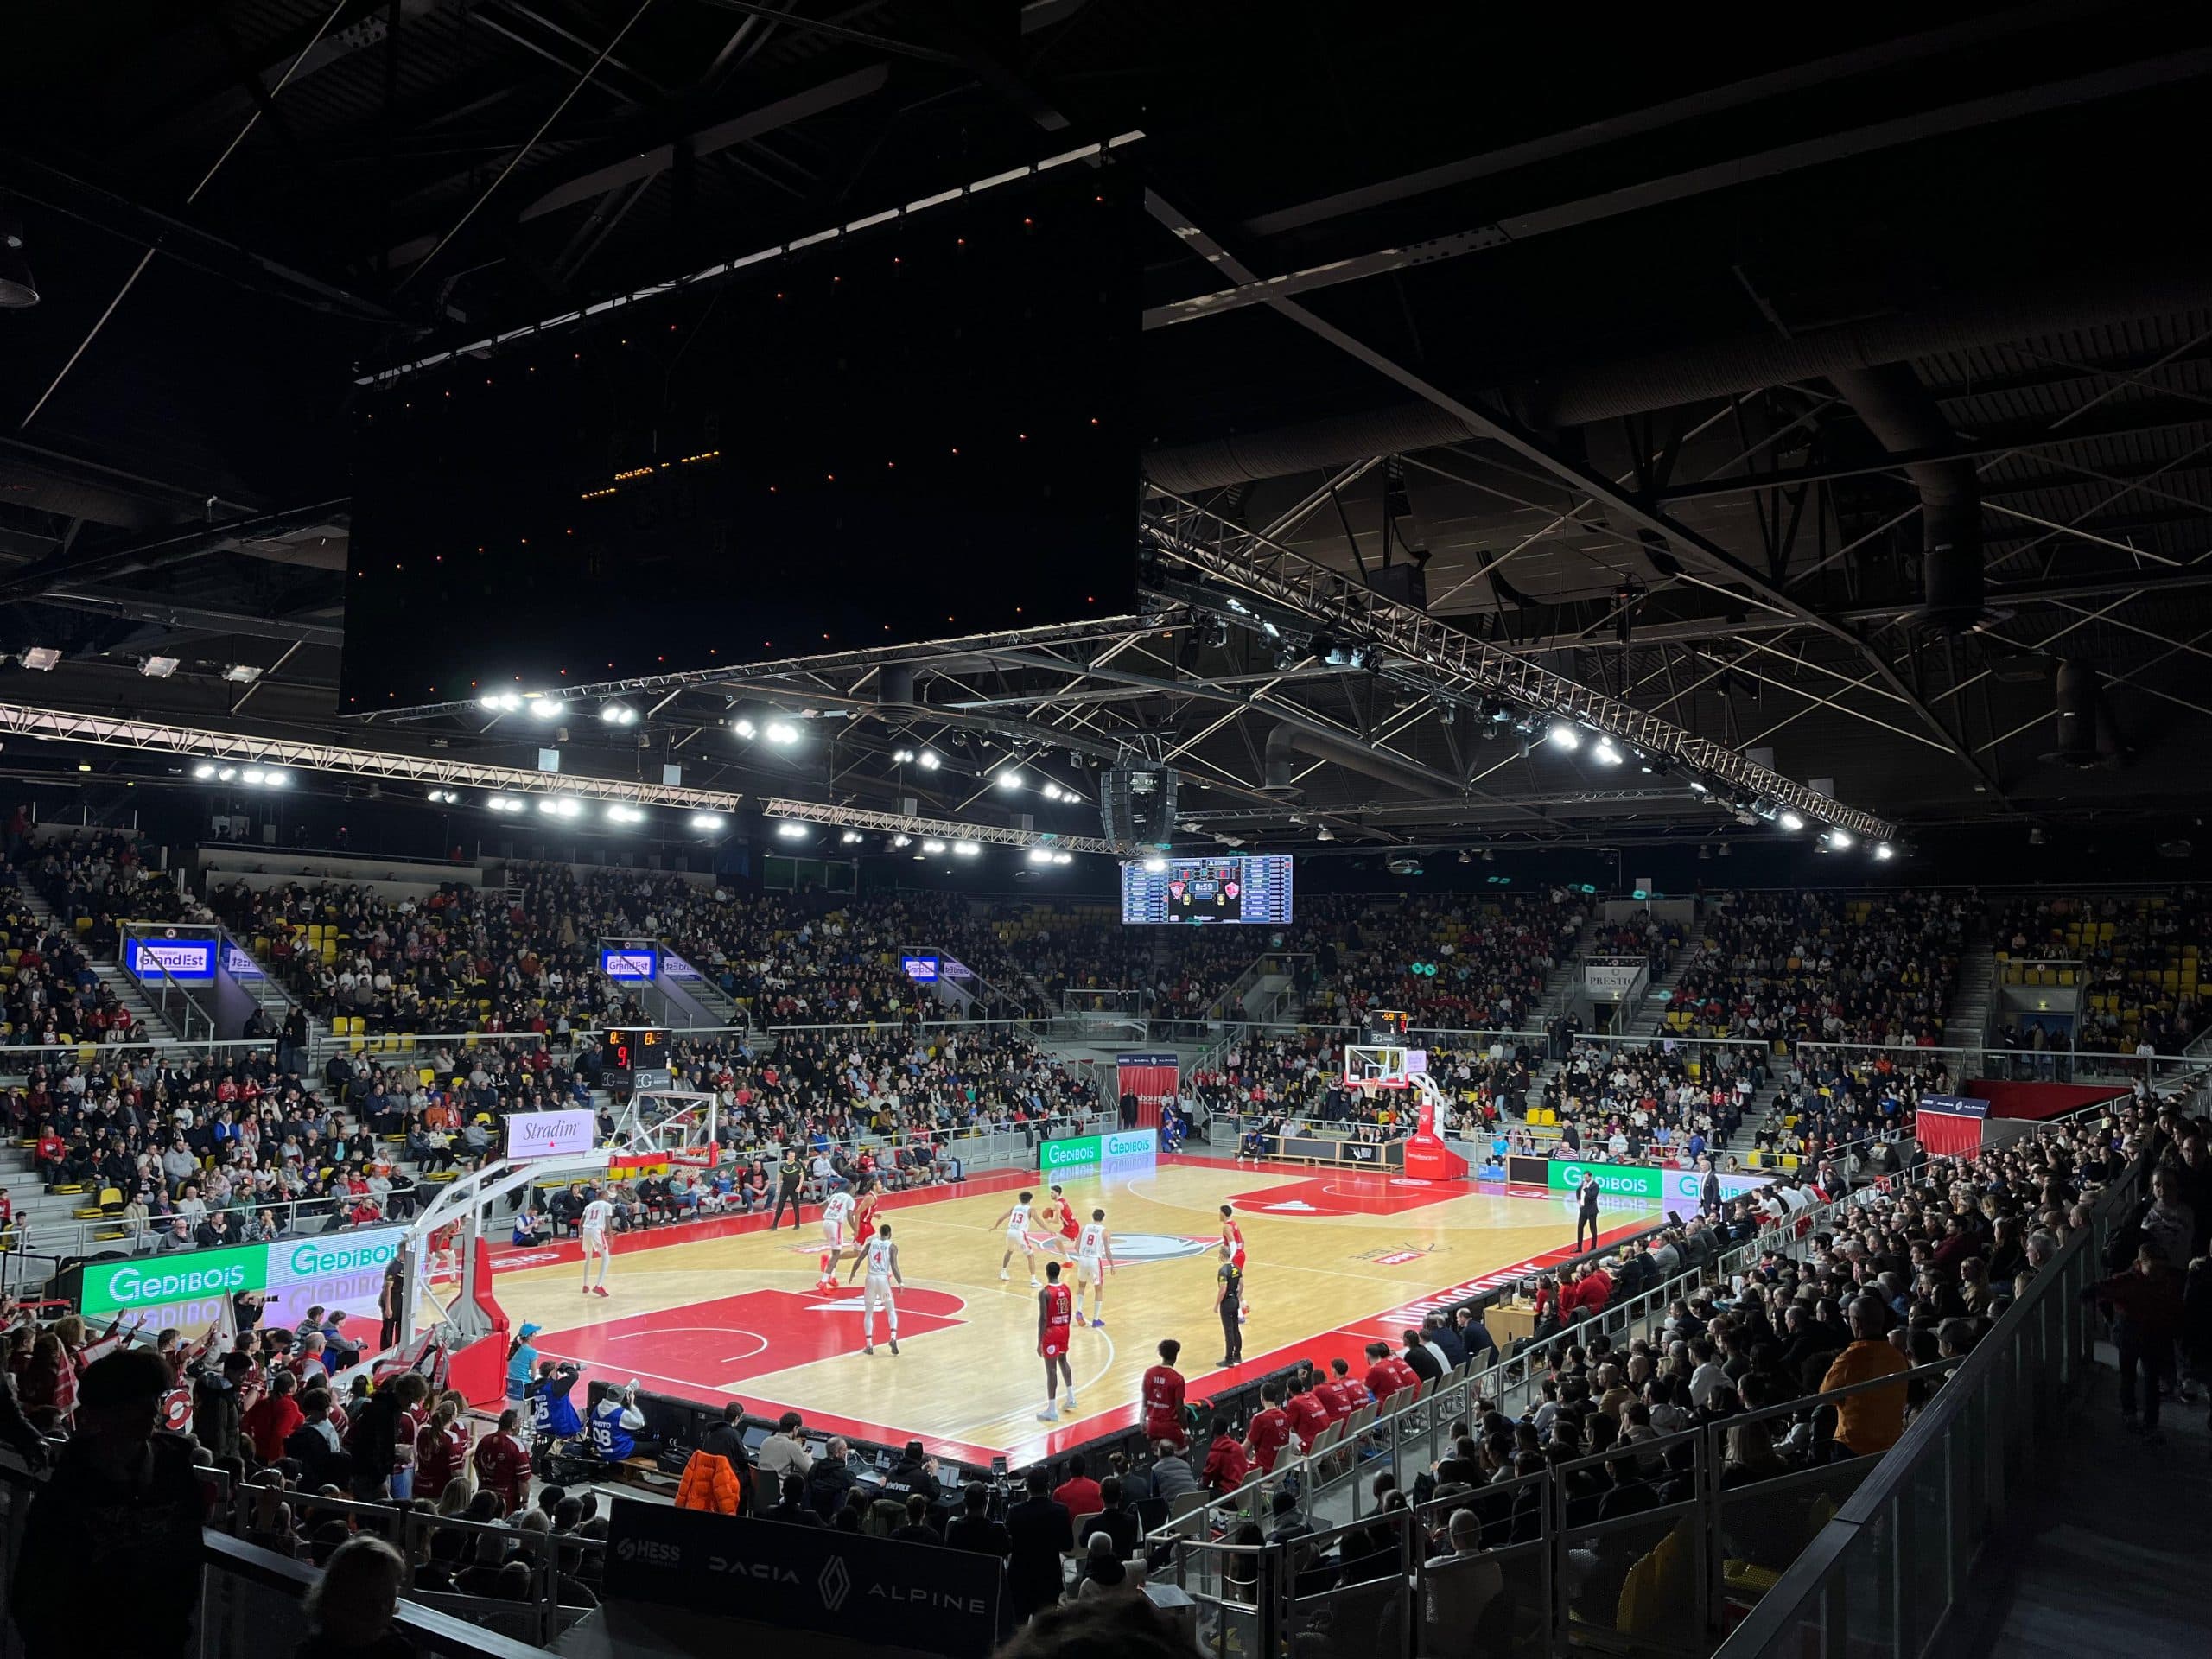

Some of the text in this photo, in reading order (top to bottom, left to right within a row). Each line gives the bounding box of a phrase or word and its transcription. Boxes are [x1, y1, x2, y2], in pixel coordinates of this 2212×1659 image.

[618, 1046, 627, 1065] 9
[523, 1120, 576, 1140] Stradim
[830, 1200, 842, 1211] 34
[1012, 1212, 1024, 1224] 13
[1086, 1234, 1095, 1246] 8
[874, 1251, 882, 1263] 4
[1057, 1298, 1068, 1313] 12
[593, 1420, 611, 1428] PHOTO
[593, 1427, 612, 1446] 08
[638, 1541, 680, 1561] HESS
[709, 1556, 800, 1583] DACIA
[868, 1583, 985, 1614] ALPINE
